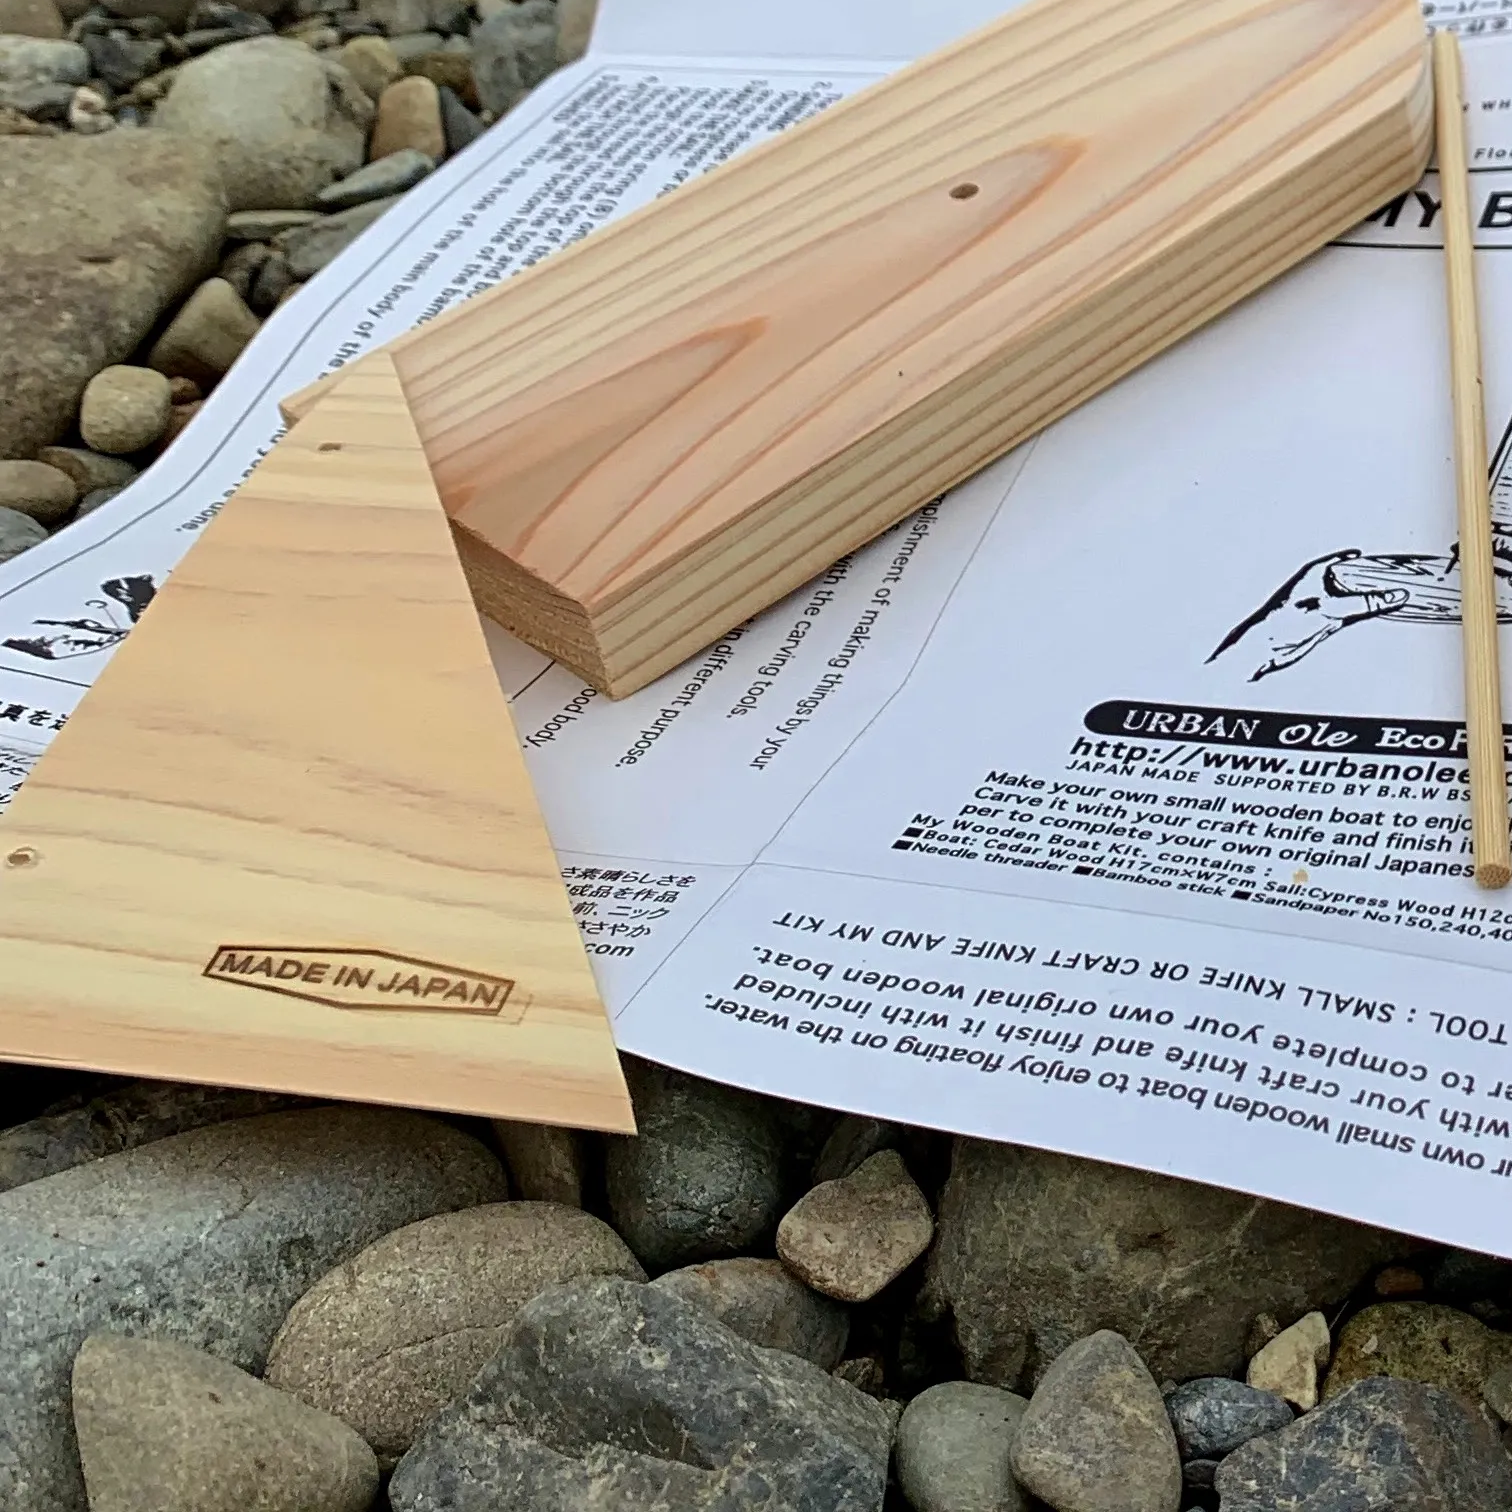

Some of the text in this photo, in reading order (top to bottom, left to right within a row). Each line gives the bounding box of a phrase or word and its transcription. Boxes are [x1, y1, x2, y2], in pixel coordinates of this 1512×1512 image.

[725, 589, 834, 719] the carving tools.
[748, 587, 891, 771] of making things by your
[1122, 708, 1261, 741] URBAN
[1279, 721, 1359, 749] Ole
[1064, 759, 1136, 777] JAPAN
[1140, 766, 1201, 783] MADE
[1213, 772, 1336, 795] SUPPORTED
[1342, 782, 1372, 797] BY
[983, 770, 1046, 790] Make
[1046, 781, 1107, 802] your
[1100, 789, 1159, 809] own
[1162, 795, 1228, 813] small
[1231, 801, 1324, 822] wooden
[1327, 806, 1386, 827] boat
[1392, 811, 1418, 828] to
[1424, 813, 1473, 834] enjo
[907, 812, 1256, 876] My Wooden Boat Kit. contains
[771, 911, 825, 933] KIT
[827, 922, 875, 942] MY
[880, 929, 947, 952] AND
[950, 937, 1037, 964] KNIFE
[218, 952, 500, 1007] MADE IN JAPAN
[1040, 949, 1140, 976] CRAFT
[1149, 960, 1190, 981] OR
[1198, 968, 1286, 1001] KNIFE
[704, 993, 790, 1031] water.
[1297, 985, 1396, 1023] SMALL
[795, 1020, 844, 1044] the
[850, 1030, 889, 1049] on
[1429, 1011, 1508, 1046] TOOL
[892, 1034, 1005, 1073] floating
[1007, 1054, 1092, 1084] enjoy
[1097, 1071, 1130, 1094] to
[1136, 1076, 1209, 1111] boat
[1213, 1091, 1329, 1134] wooden
[1335, 1121, 1416, 1154] small
[1421, 1140, 1485, 1170] own
